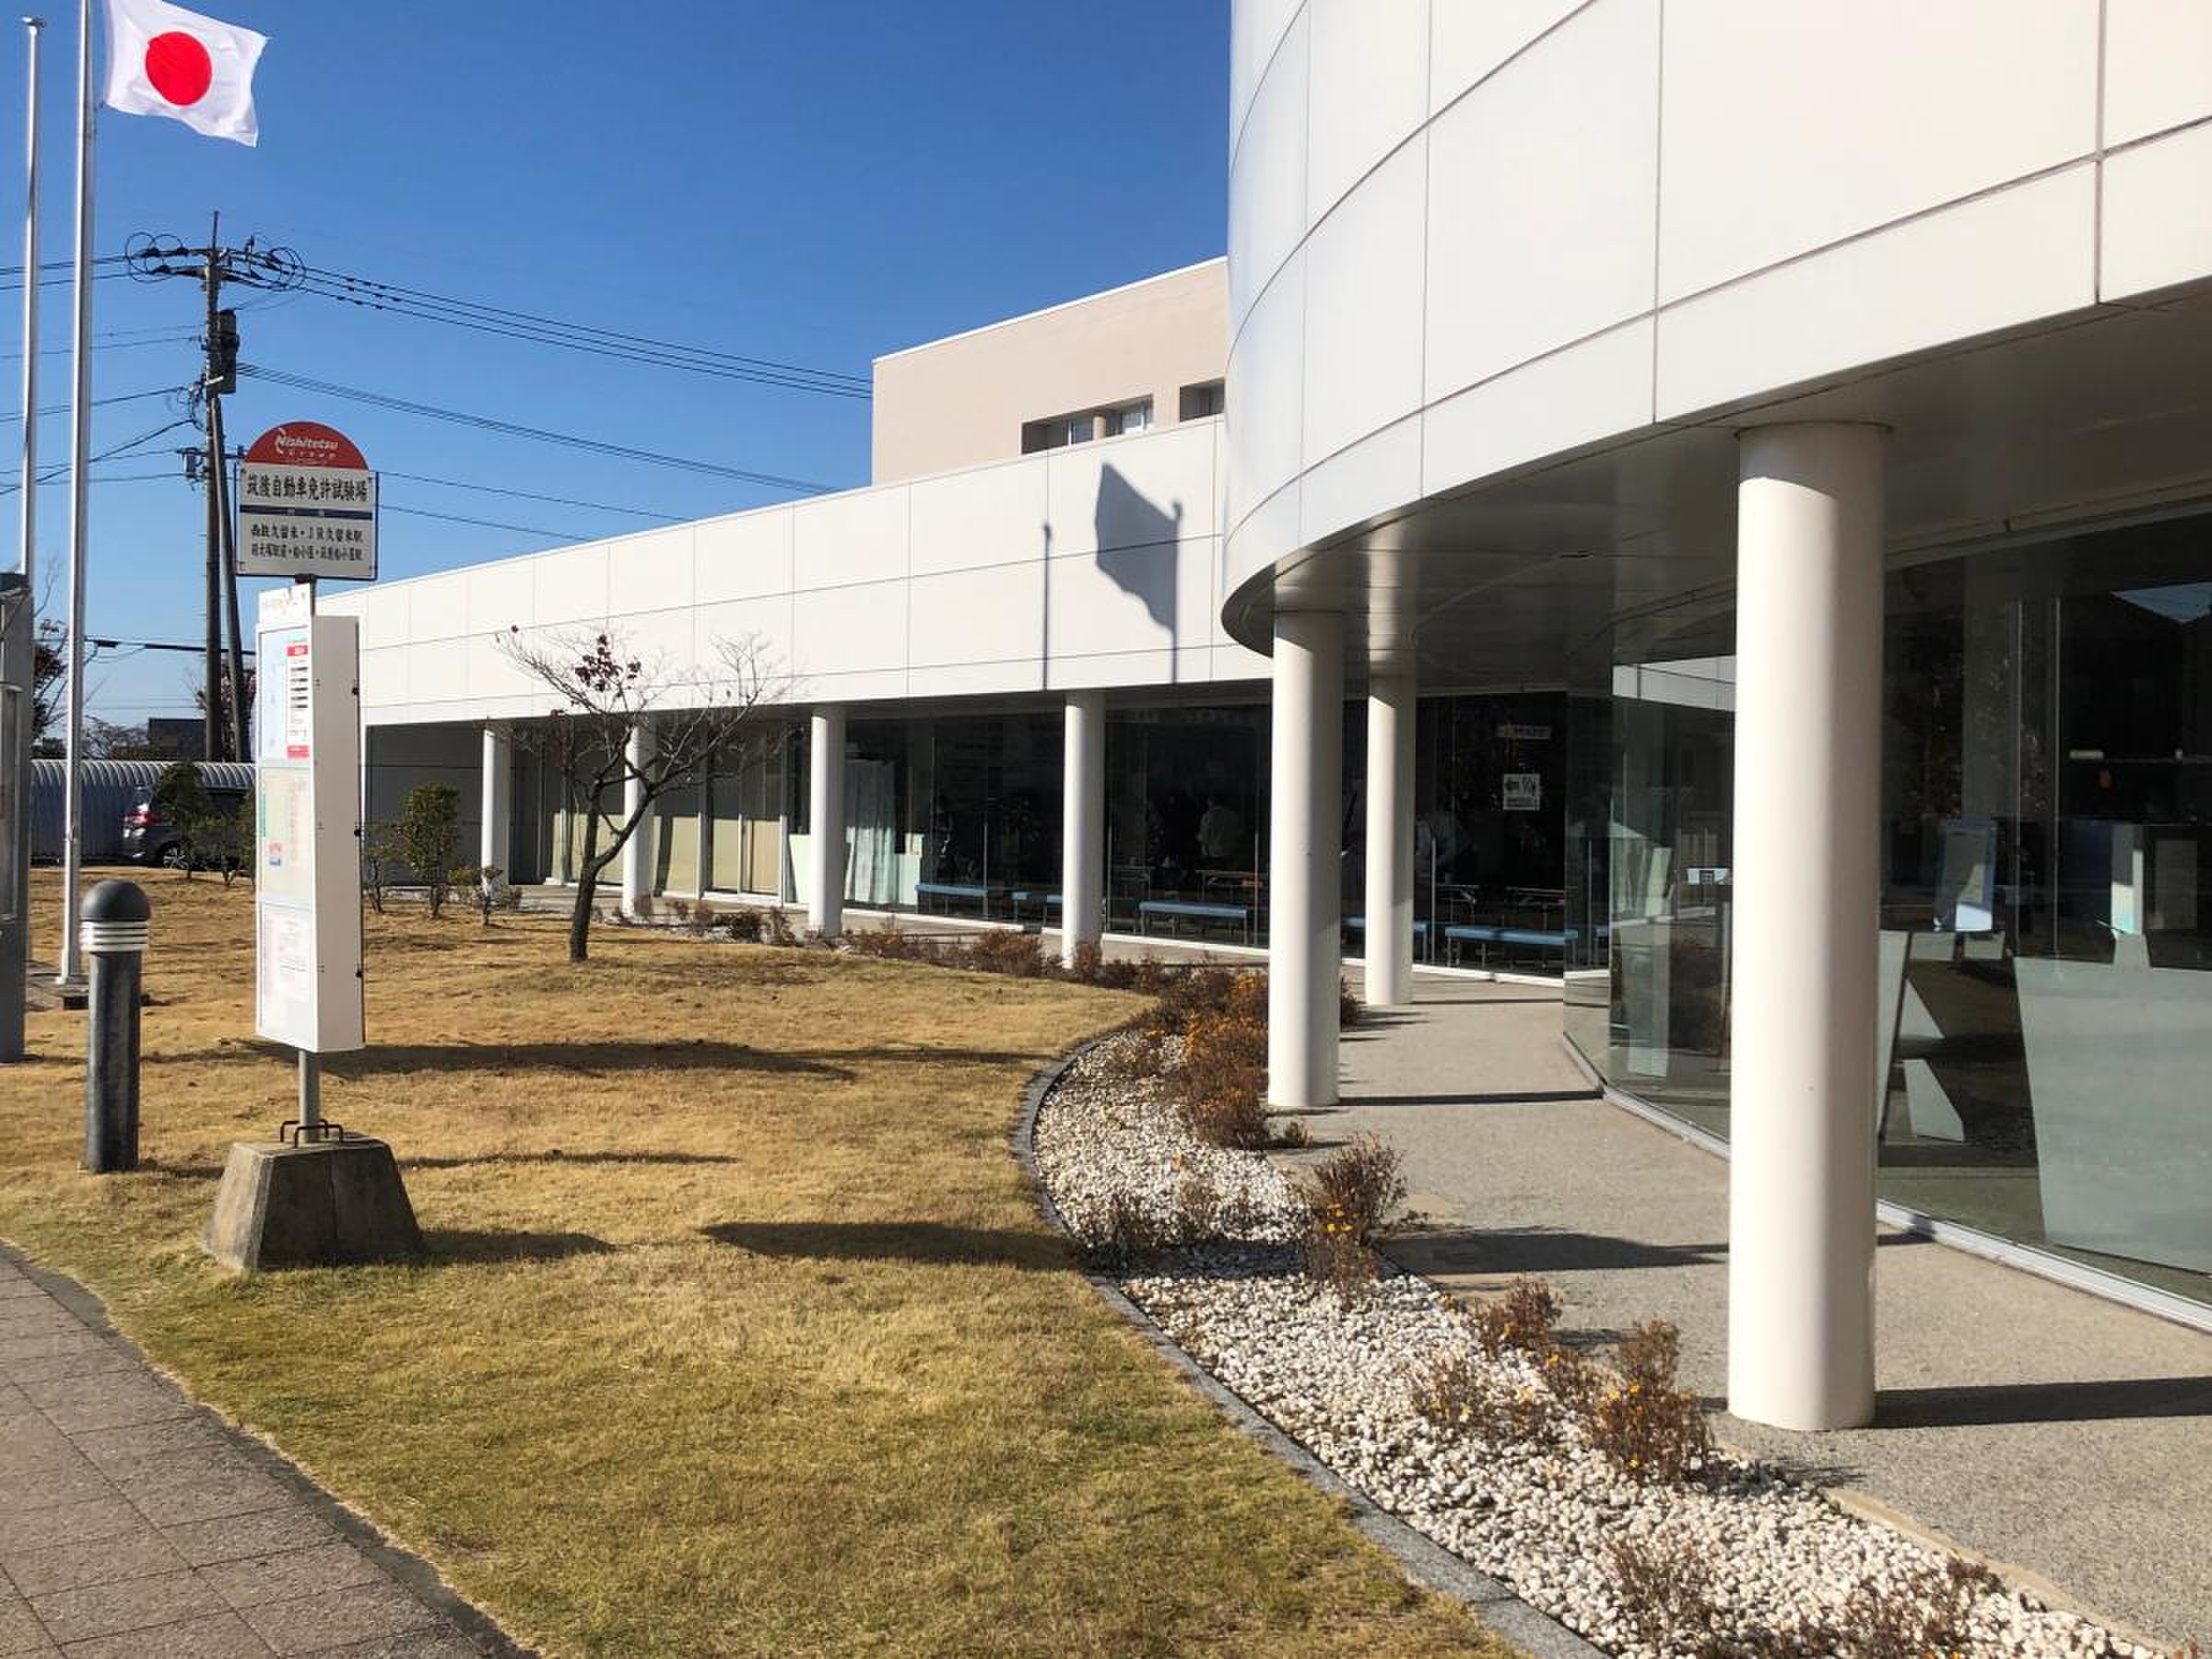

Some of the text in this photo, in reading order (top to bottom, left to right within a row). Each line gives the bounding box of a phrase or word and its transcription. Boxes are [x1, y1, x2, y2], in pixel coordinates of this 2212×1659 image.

[275, 429, 338, 453] Nishitetsu
[247, 475, 367, 500] 筑後自動車免許試験場
